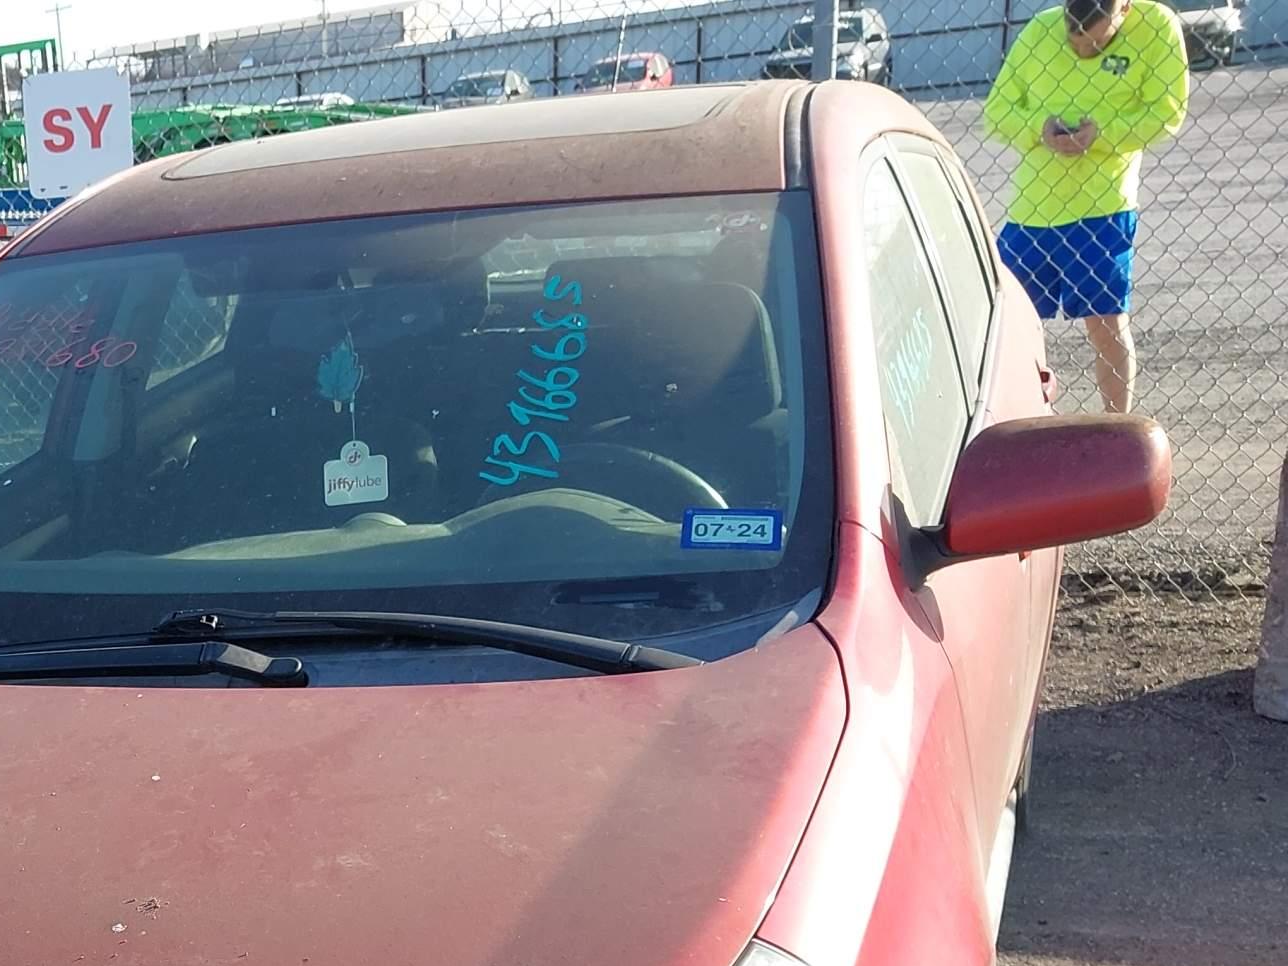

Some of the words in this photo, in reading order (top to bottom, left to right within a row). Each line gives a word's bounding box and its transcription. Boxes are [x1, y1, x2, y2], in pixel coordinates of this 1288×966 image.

[42, 104, 112, 153] SY
[694, 523, 724, 537] 07
[737, 523, 767, 538] 24
